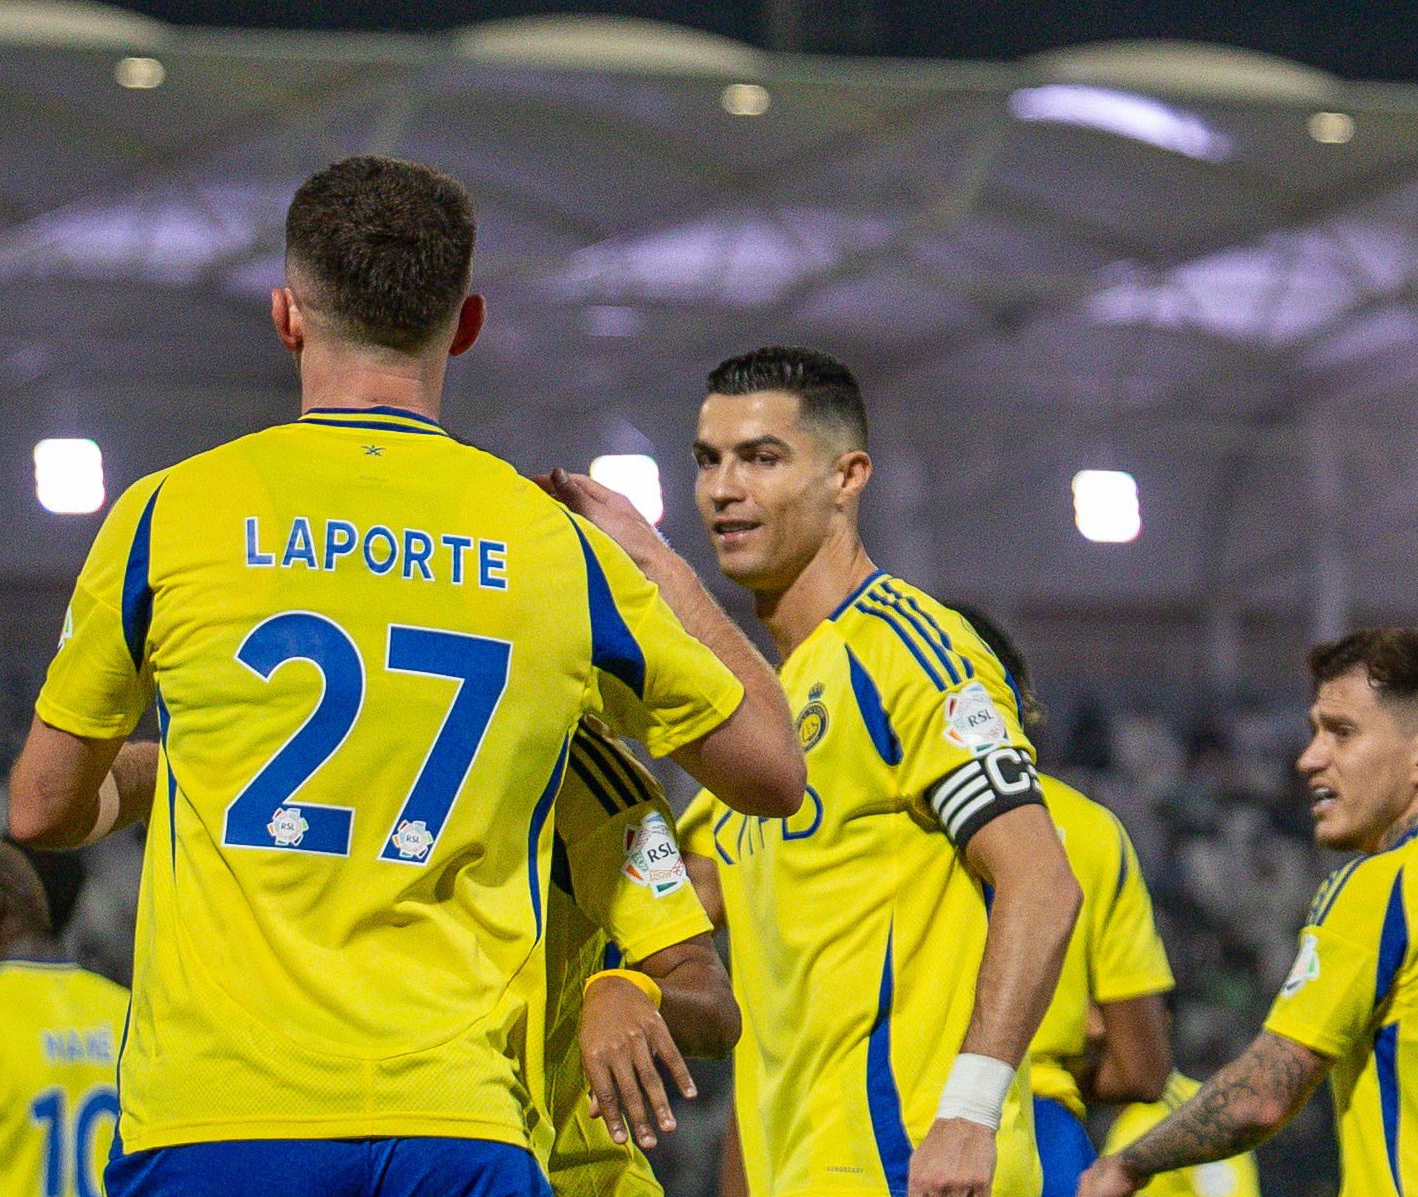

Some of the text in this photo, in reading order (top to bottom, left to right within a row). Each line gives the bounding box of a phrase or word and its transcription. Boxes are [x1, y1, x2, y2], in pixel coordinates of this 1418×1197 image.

[245, 516, 508, 592] LAPORTE
[221, 610, 513, 866] 27
[967, 708, 994, 728] RSL
[985, 747, 1031, 796] C
[647, 841, 677, 863] RSL
